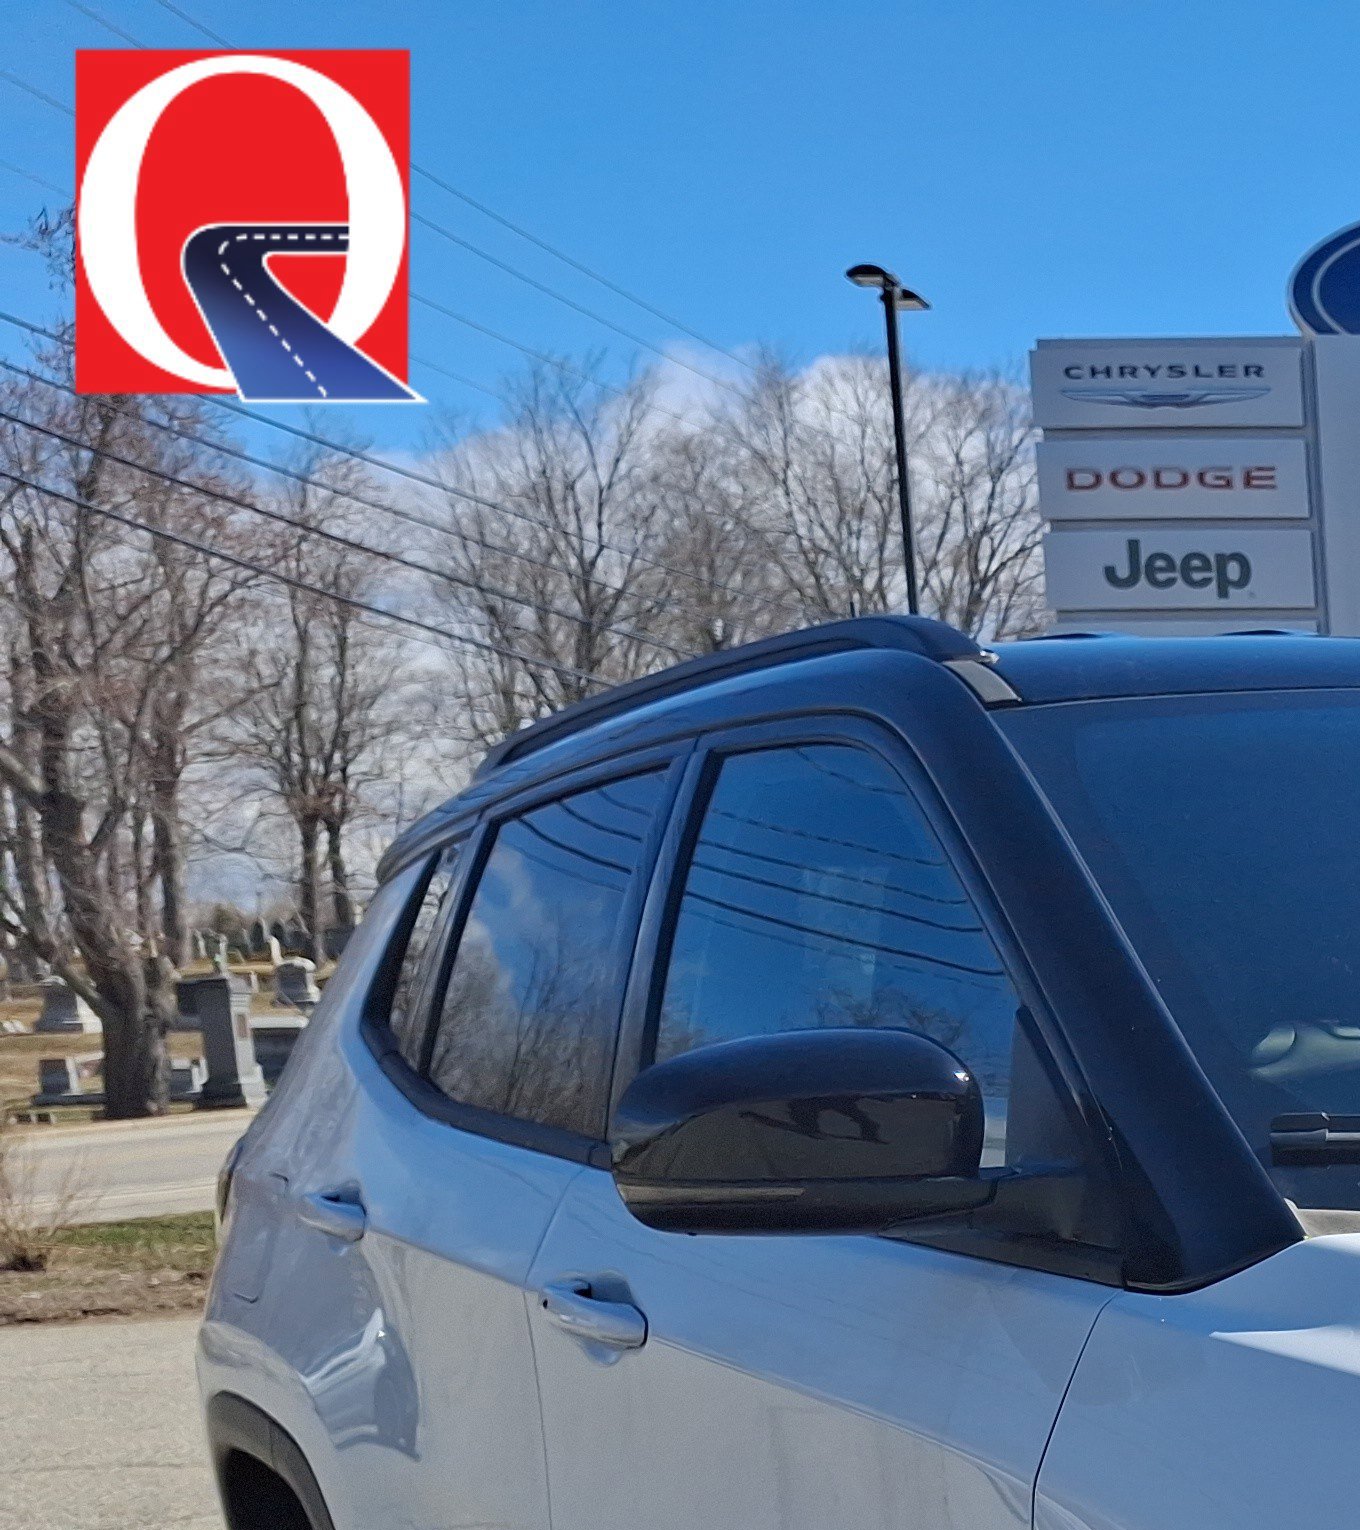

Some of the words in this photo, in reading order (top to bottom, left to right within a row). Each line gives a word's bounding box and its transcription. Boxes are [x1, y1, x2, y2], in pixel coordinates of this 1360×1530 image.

[1063, 363, 1266, 381] CHRYSLER
[1066, 466, 1278, 491] DODGE
[1103, 538, 1252, 600] Jeep
